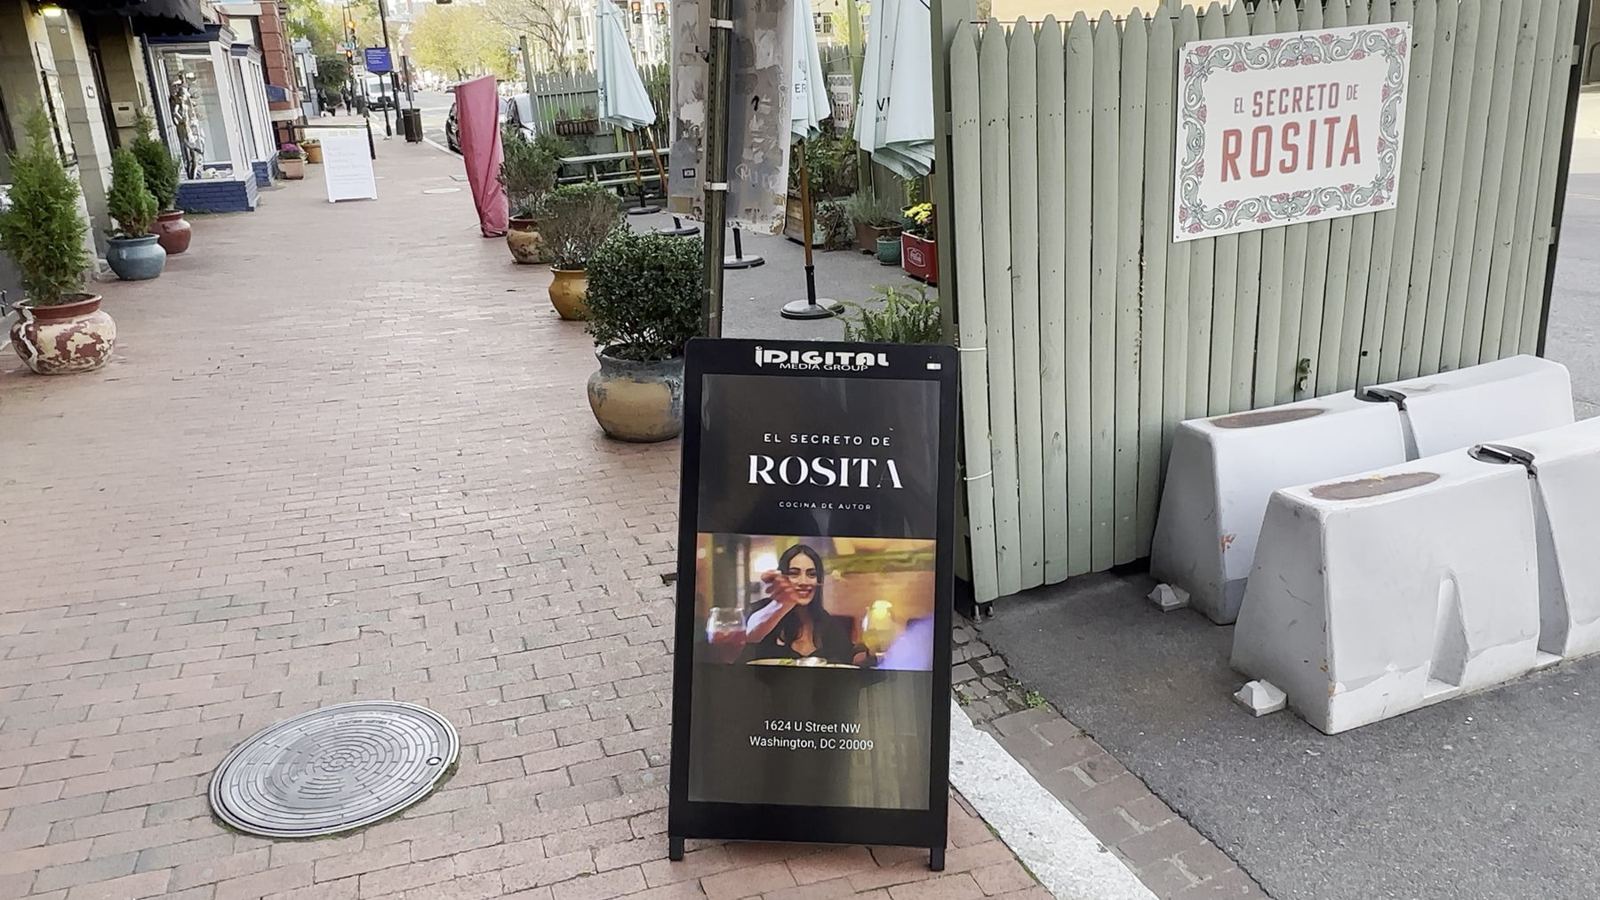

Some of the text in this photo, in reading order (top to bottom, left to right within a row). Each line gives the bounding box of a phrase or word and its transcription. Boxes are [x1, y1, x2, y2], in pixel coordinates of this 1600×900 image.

[1234, 82, 1359, 118] EL SECRETO DE
[1220, 114, 1361, 183] ROSITA
[780, 362, 869, 373] MEDIA GROUP
[763, 433, 891, 447] EL SECRETO DE
[748, 454, 903, 489] ROSITA
[779, 501, 872, 511] COCINA DE AUTOR
[764, 720, 861, 734] 1624 U Street NW
[749, 735, 874, 751] Washington, DC 20009
